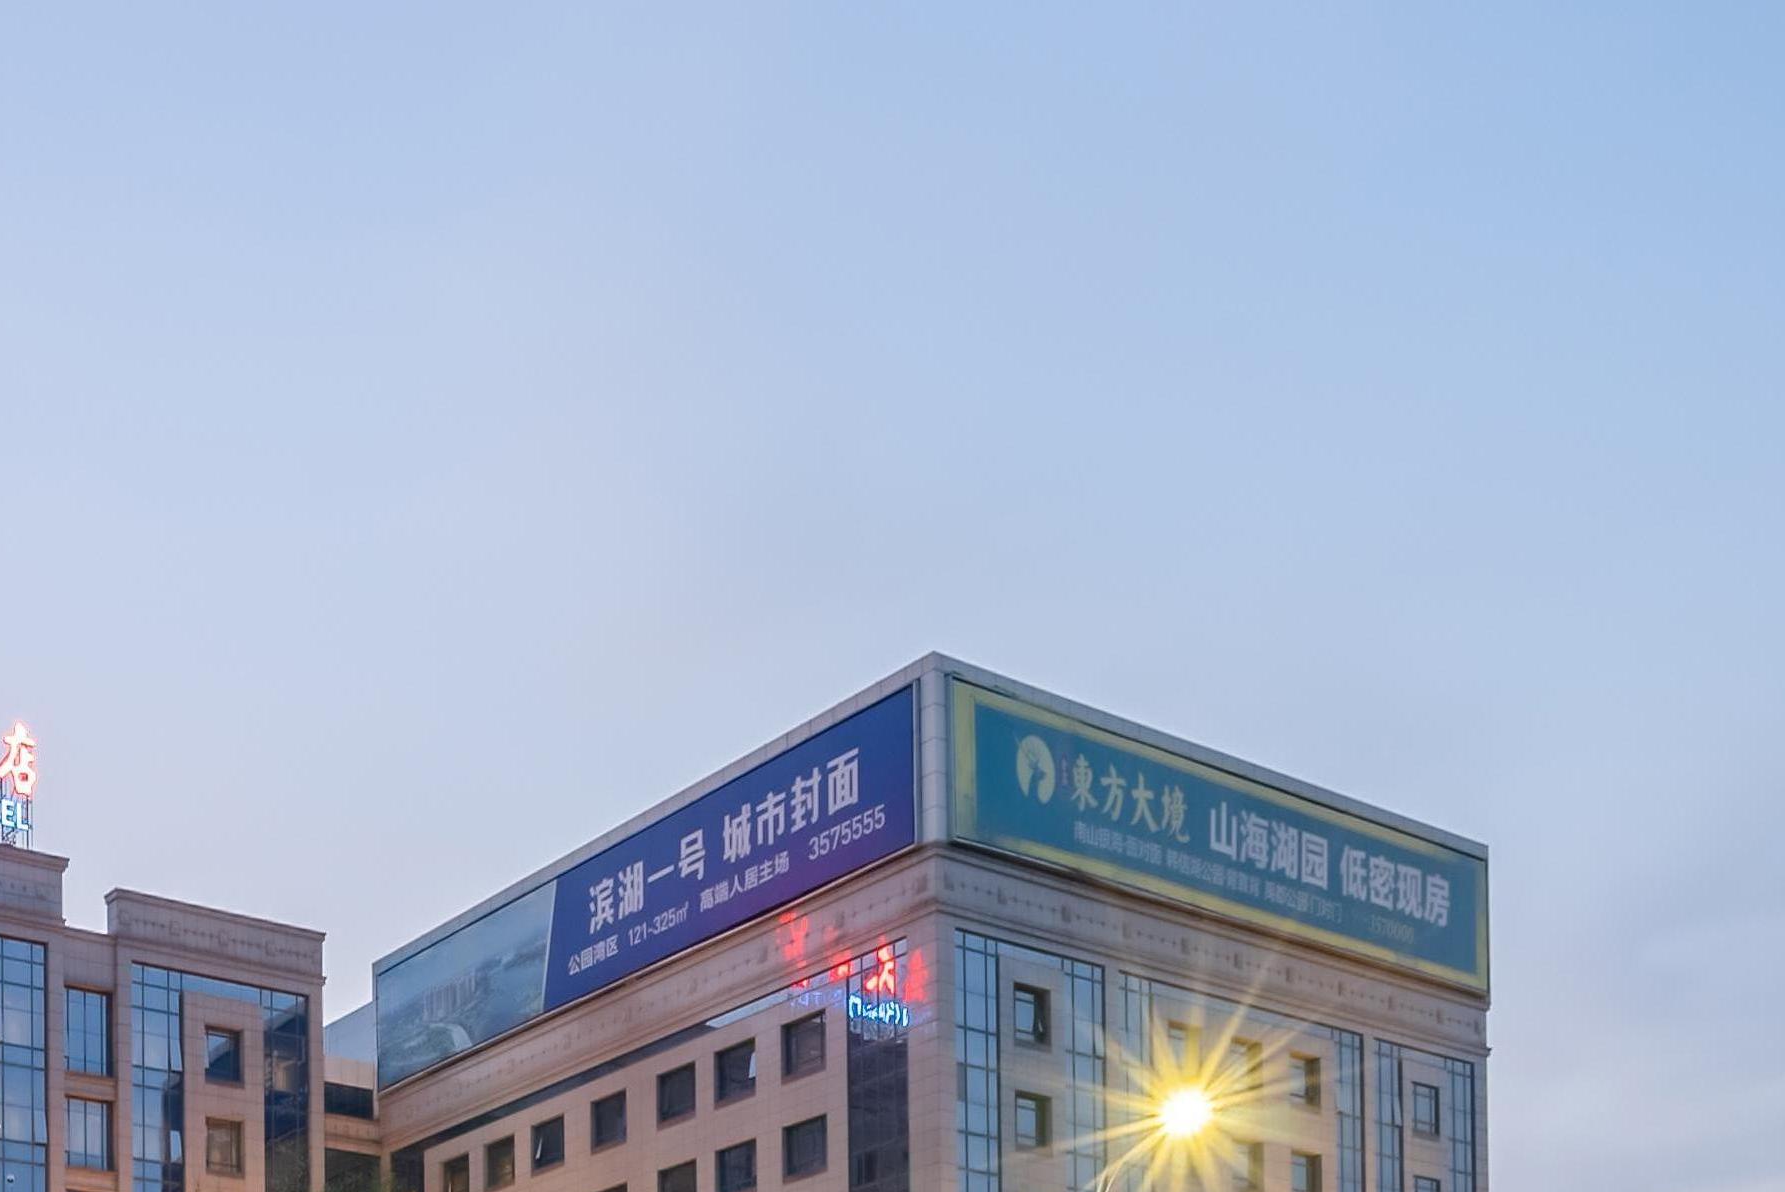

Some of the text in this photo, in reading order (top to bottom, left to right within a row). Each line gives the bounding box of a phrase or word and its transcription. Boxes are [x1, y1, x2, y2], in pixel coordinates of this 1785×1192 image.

[567, 935, 619, 977] 公园湾区
[699, 851, 790, 913] 高端人居主场
[808, 803, 886, 861] 3575555
[589, 747, 860, 935] 滨湖一号 城市封面
[1210, 801, 1329, 891] 山海湖园
[1340, 845, 1451, 928] 低密现房
